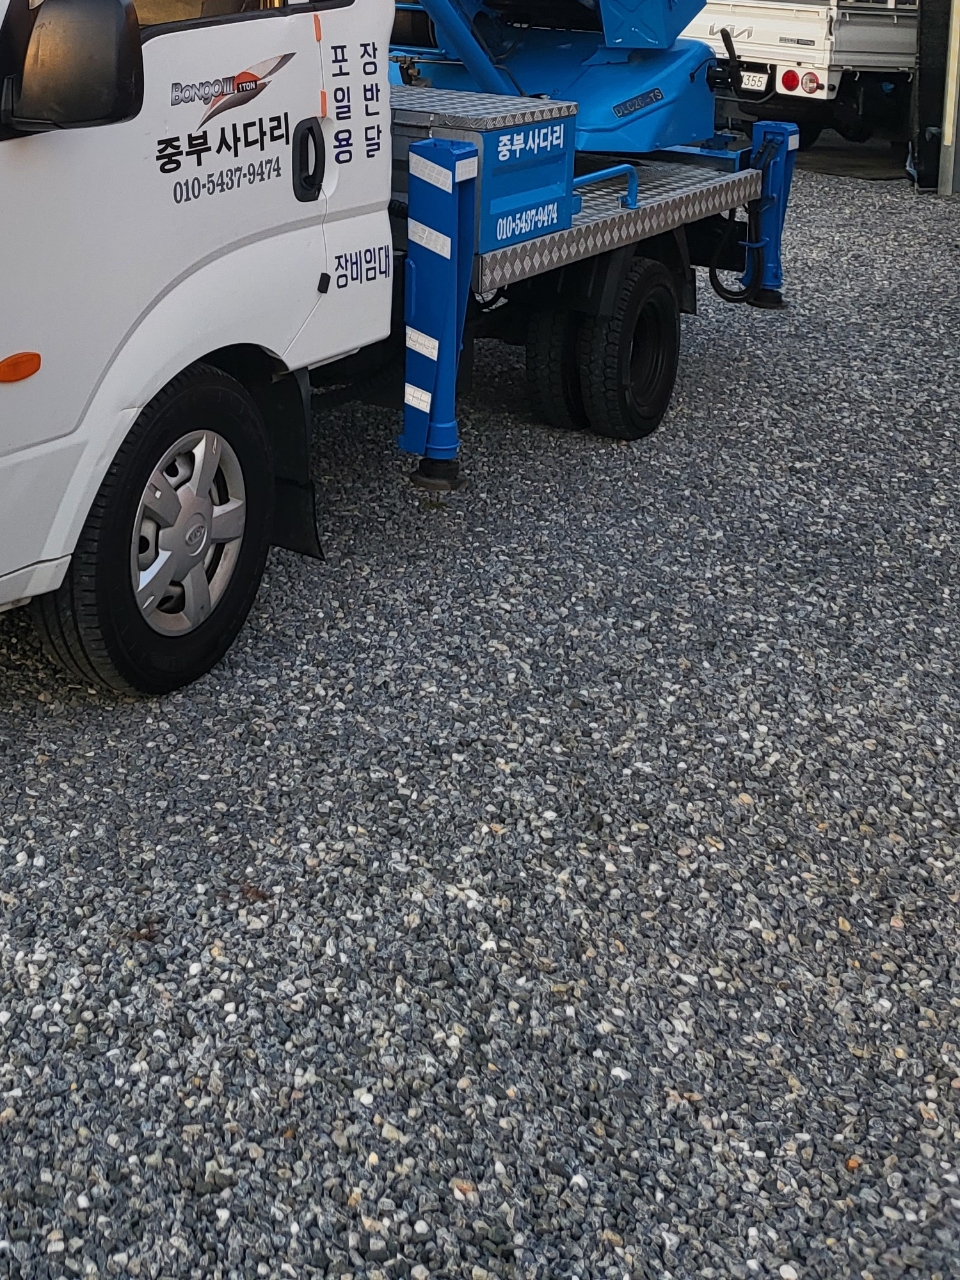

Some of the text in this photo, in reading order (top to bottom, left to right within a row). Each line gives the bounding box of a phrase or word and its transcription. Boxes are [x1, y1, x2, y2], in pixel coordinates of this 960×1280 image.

[497, 123, 564, 161] 중부사다리
[173, 156, 282, 204] 010-5437-9474
[496, 202, 558, 241] 010-5437-9474
[334, 245, 390, 289] 장비임대
